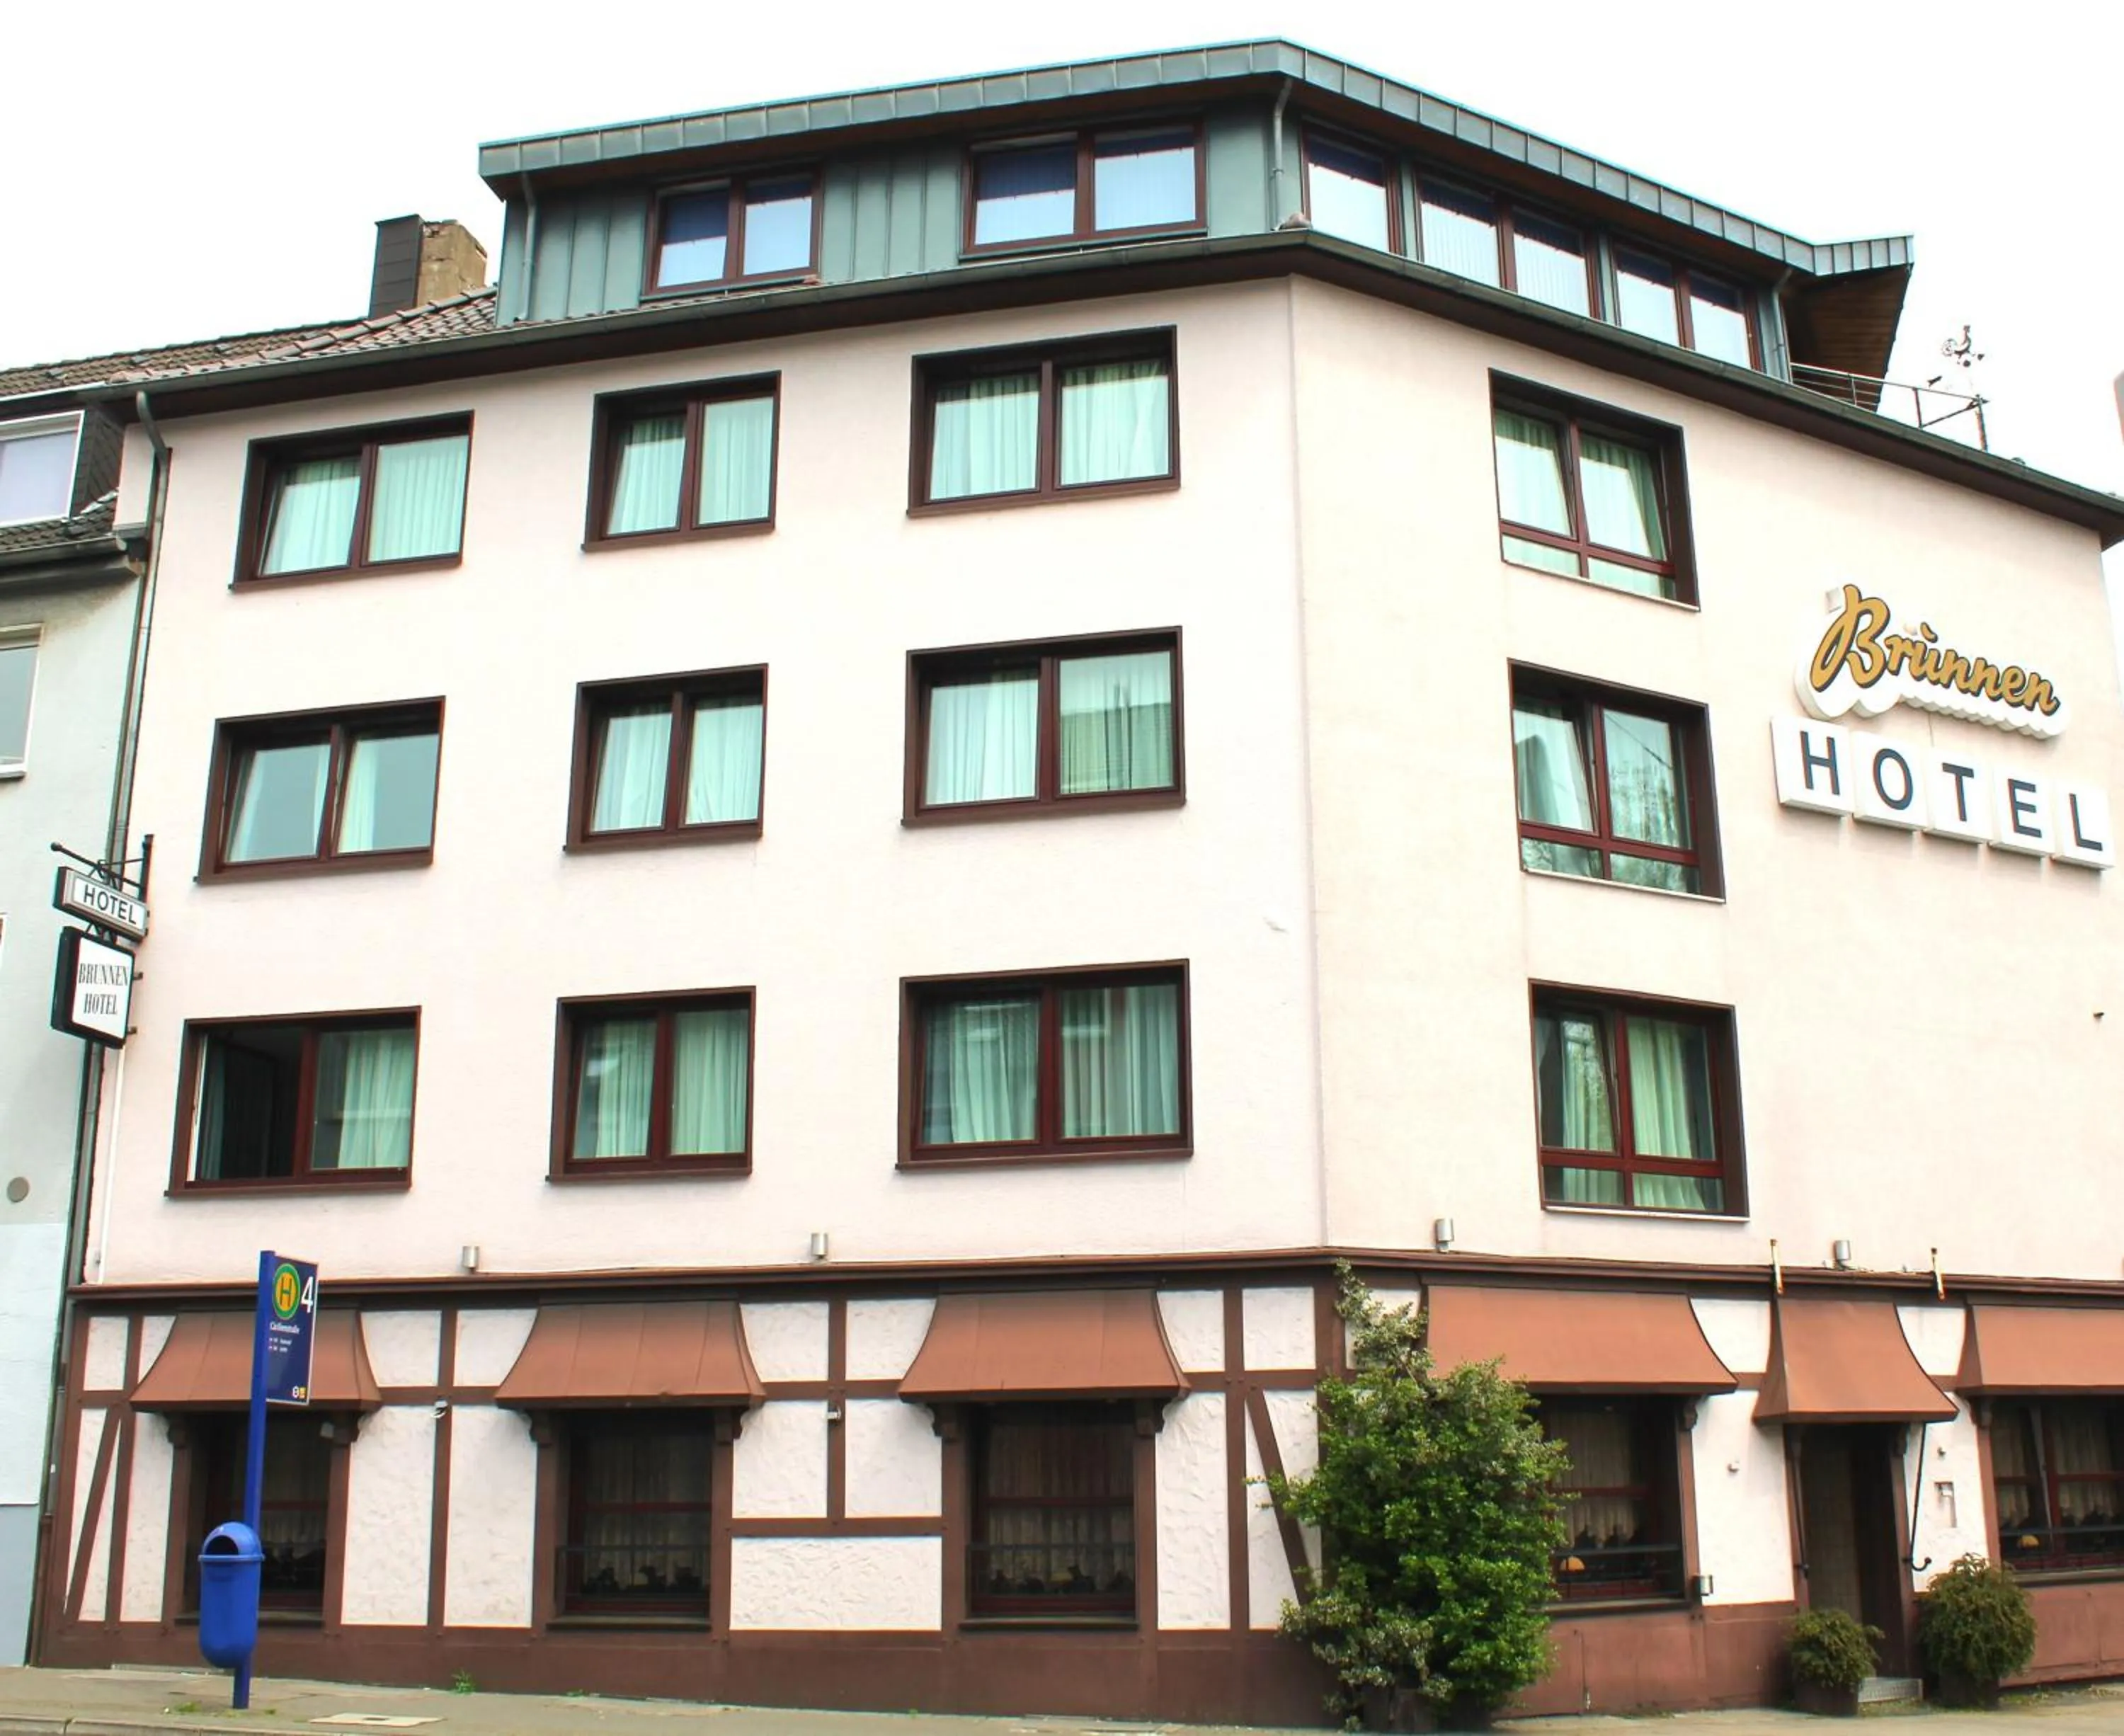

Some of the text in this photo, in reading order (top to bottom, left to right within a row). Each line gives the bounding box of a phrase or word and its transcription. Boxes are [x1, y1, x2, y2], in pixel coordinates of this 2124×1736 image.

[1800, 731, 2103, 852] HOTEL
[83, 884, 137, 925] HOTEL
[79, 962, 128, 986] BRUNNEN
[84, 993, 118, 1015] HOTEL
[279, 1277, 292, 1307] H
[301, 1276, 314, 1313] 4
